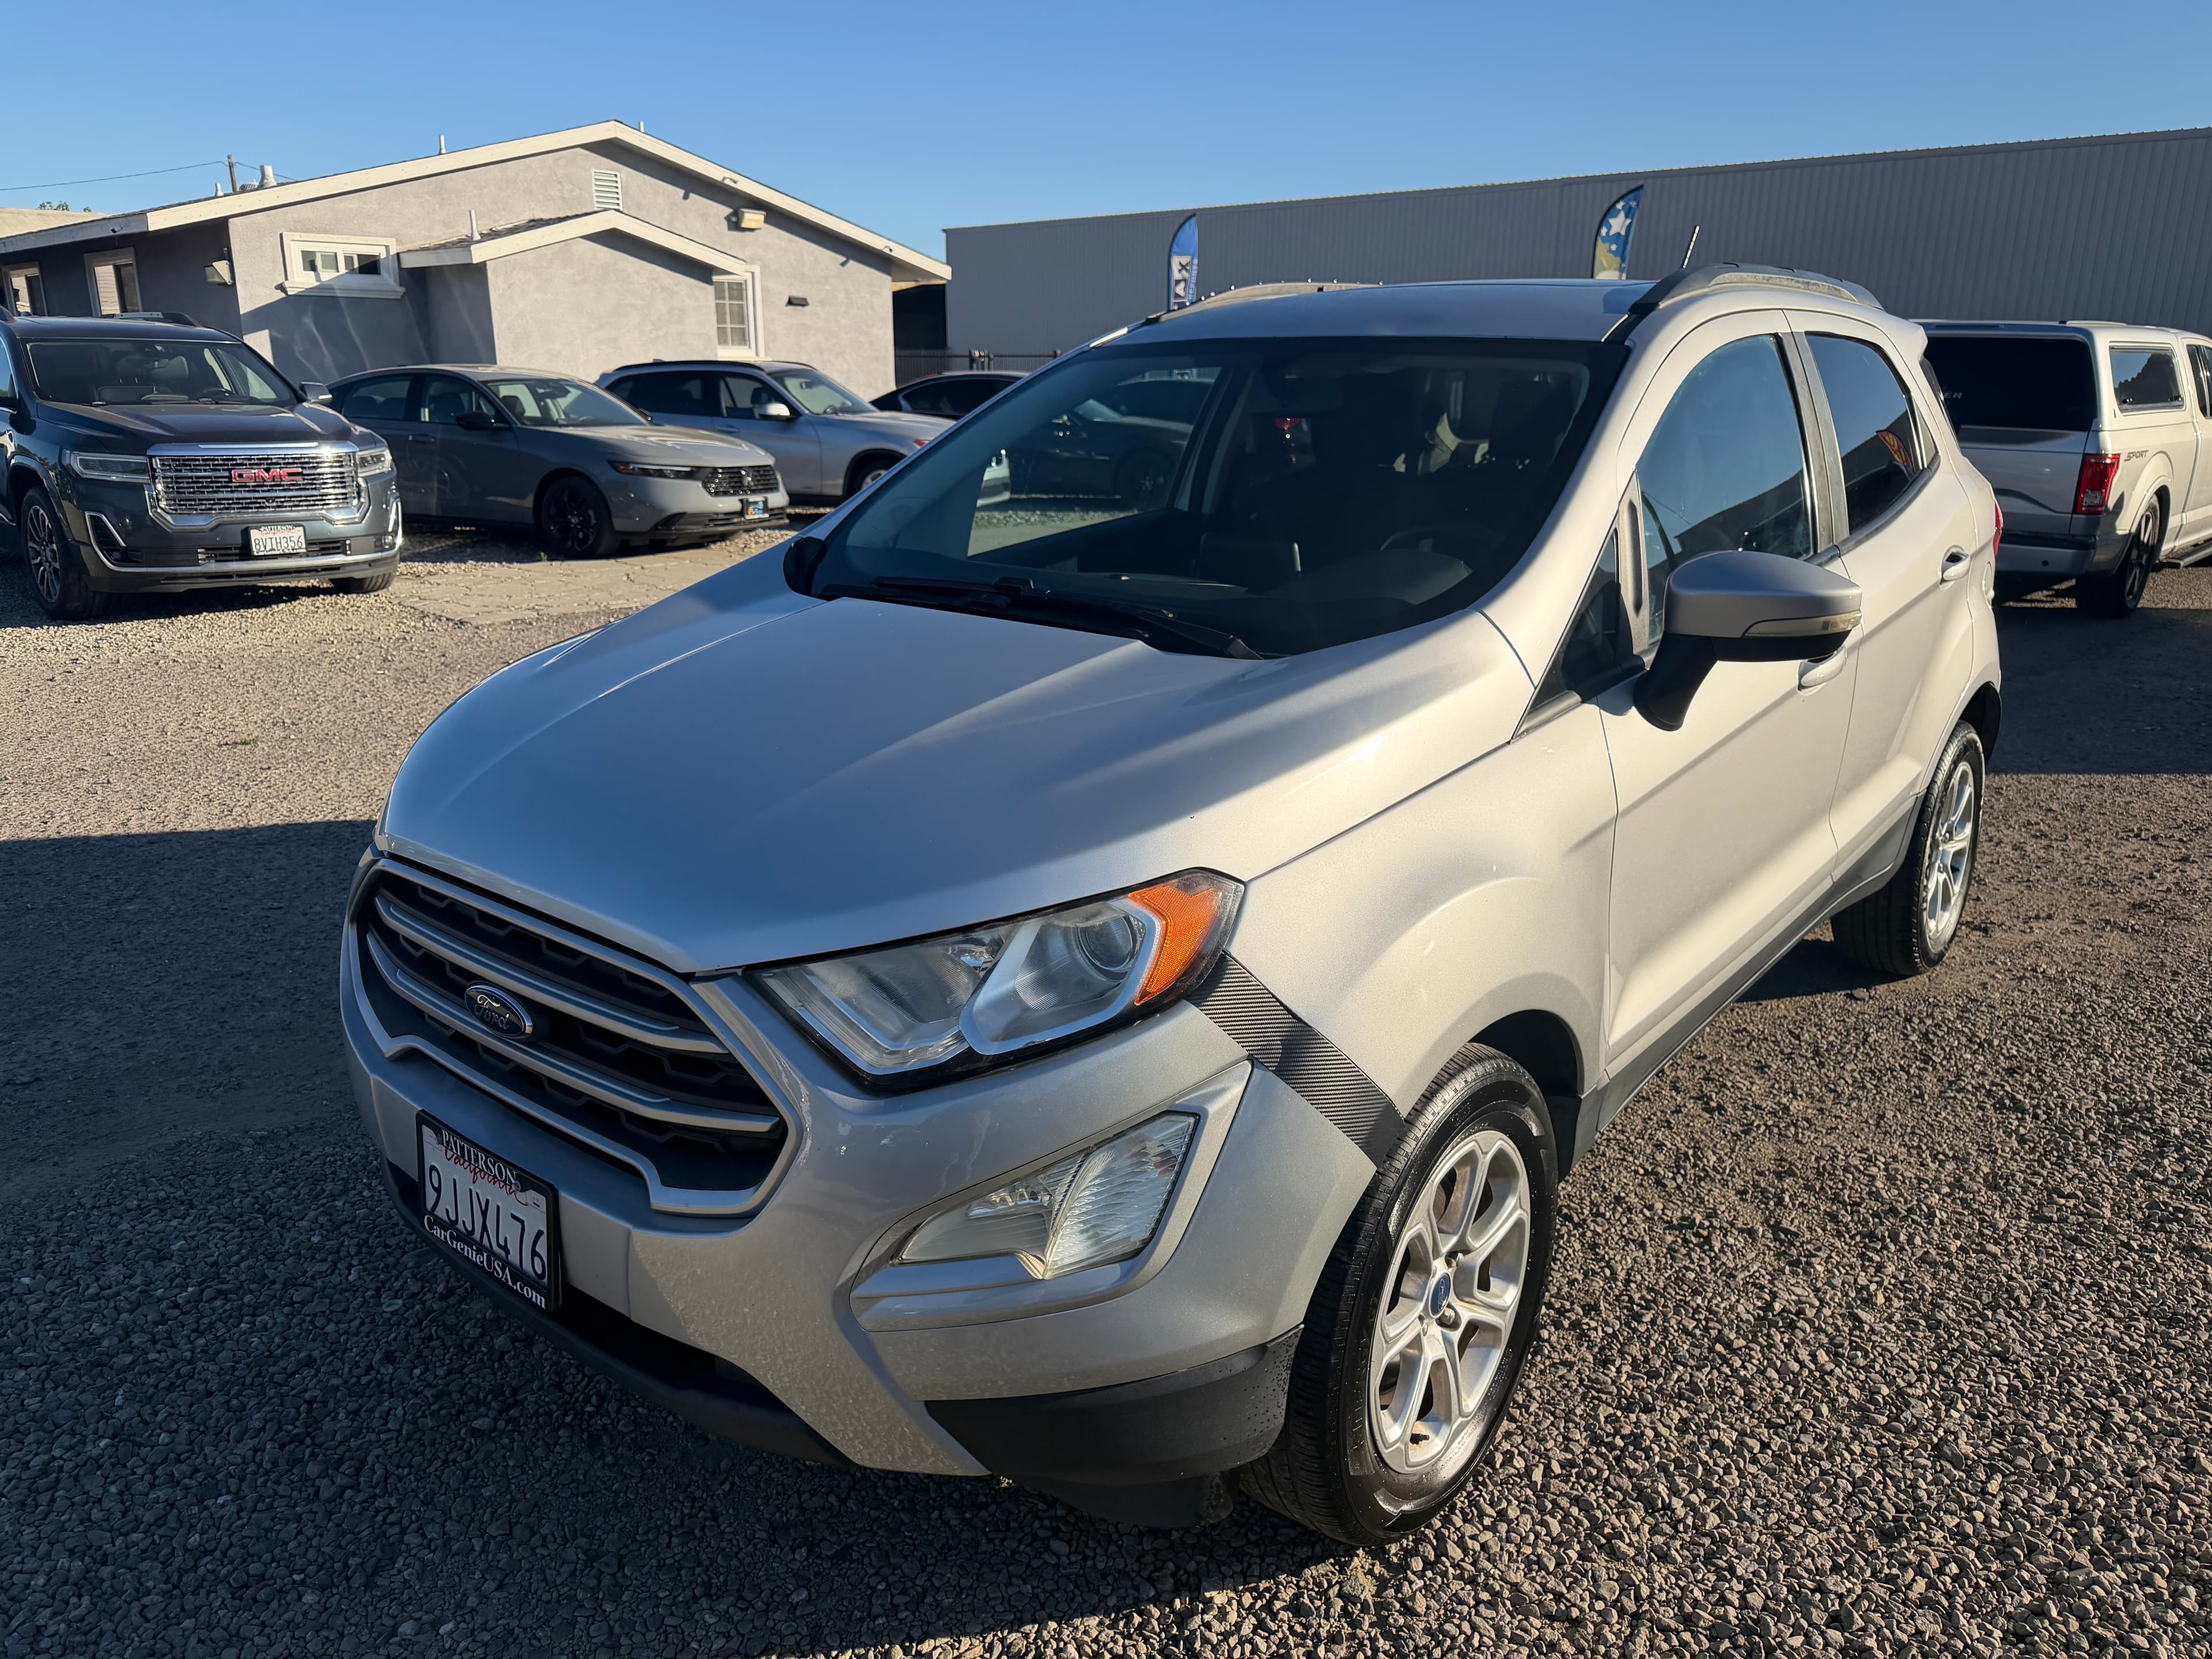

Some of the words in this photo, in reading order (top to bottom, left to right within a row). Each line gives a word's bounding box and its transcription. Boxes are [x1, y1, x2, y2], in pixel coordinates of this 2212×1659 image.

[2124, 449, 2149, 461] SPORT
[232, 468, 302, 482] GMC
[254, 535, 302, 551] 8VIH356
[474, 994, 509, 1030] Ford
[442, 1129, 517, 1184] PATTERSON
[429, 1164, 546, 1281] 9JJX476
[424, 1214, 546, 1309] CarGenieUSA.com
